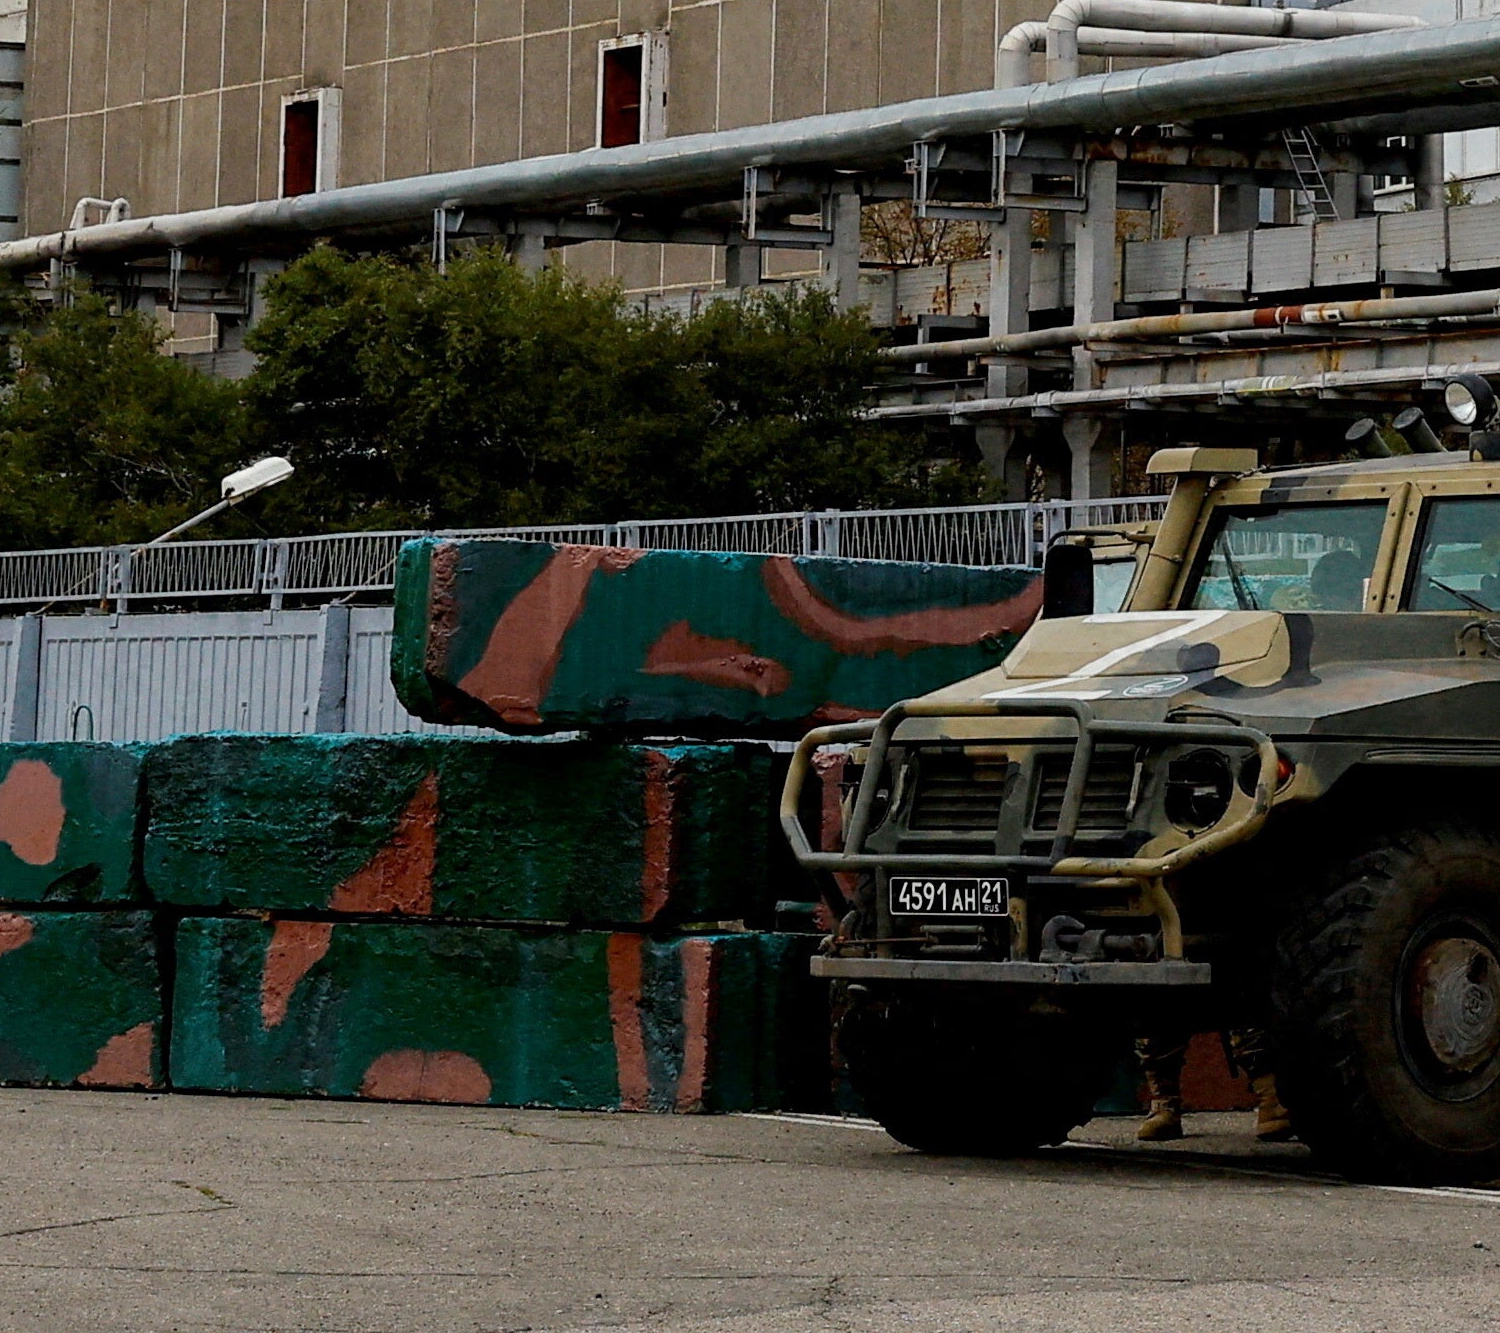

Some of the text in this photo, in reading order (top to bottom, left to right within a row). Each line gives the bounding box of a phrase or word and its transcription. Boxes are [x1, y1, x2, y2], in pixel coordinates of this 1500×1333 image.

[980, 610, 1230, 700] Z
[981, 881, 1002, 904] 21
[983, 903, 1000, 913] RUS
